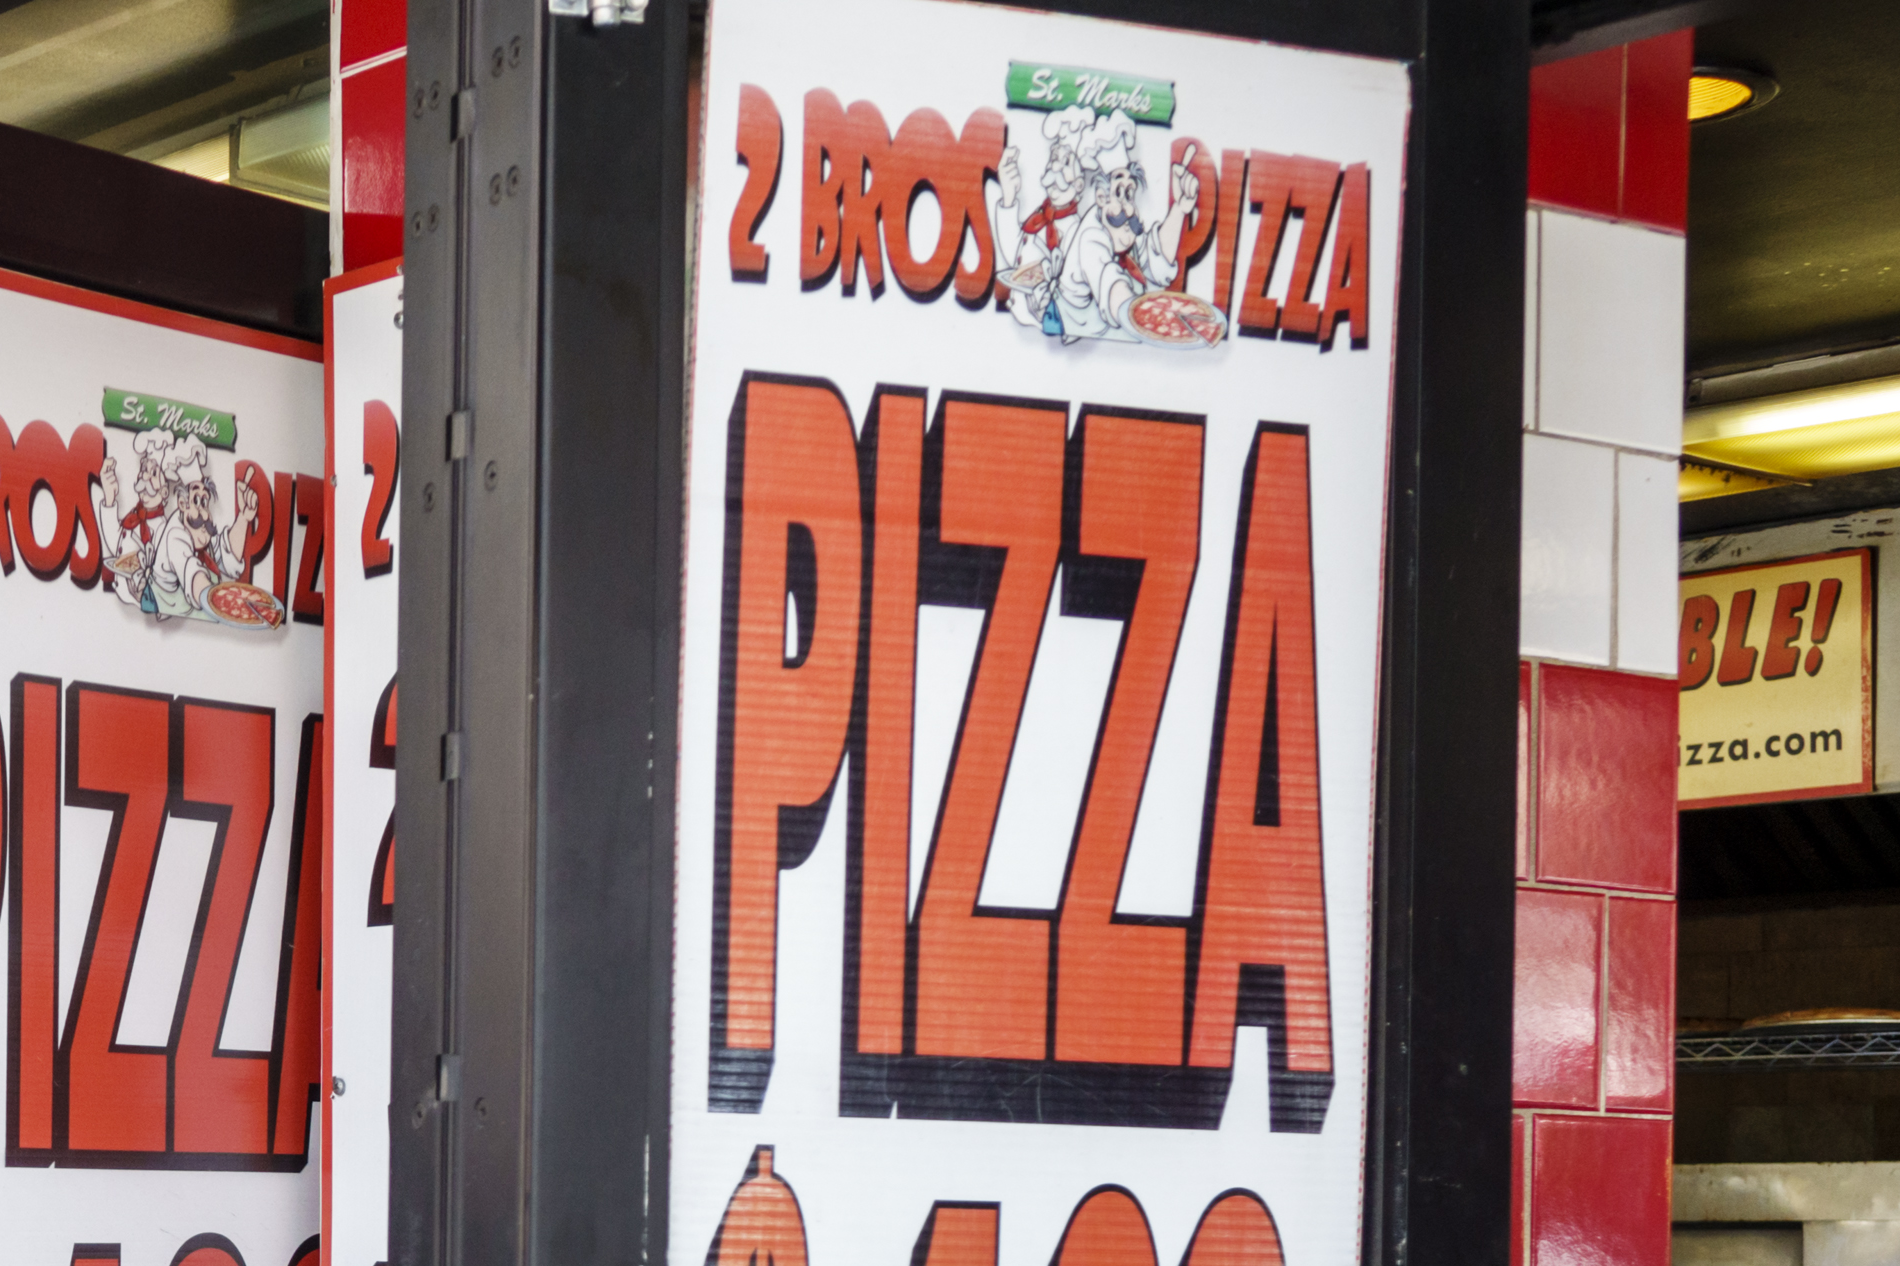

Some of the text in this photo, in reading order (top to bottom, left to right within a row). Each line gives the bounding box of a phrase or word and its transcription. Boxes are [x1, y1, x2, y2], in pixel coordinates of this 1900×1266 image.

[1027, 69, 1152, 114] St. Marks
[729, 83, 783, 283] 2
[1168, 137, 1370, 354] PIZZA
[120, 396, 219, 439] St. Marks
[1679, 578, 1842, 692] BLE!
[707, 370, 1334, 1134] PIZZA
